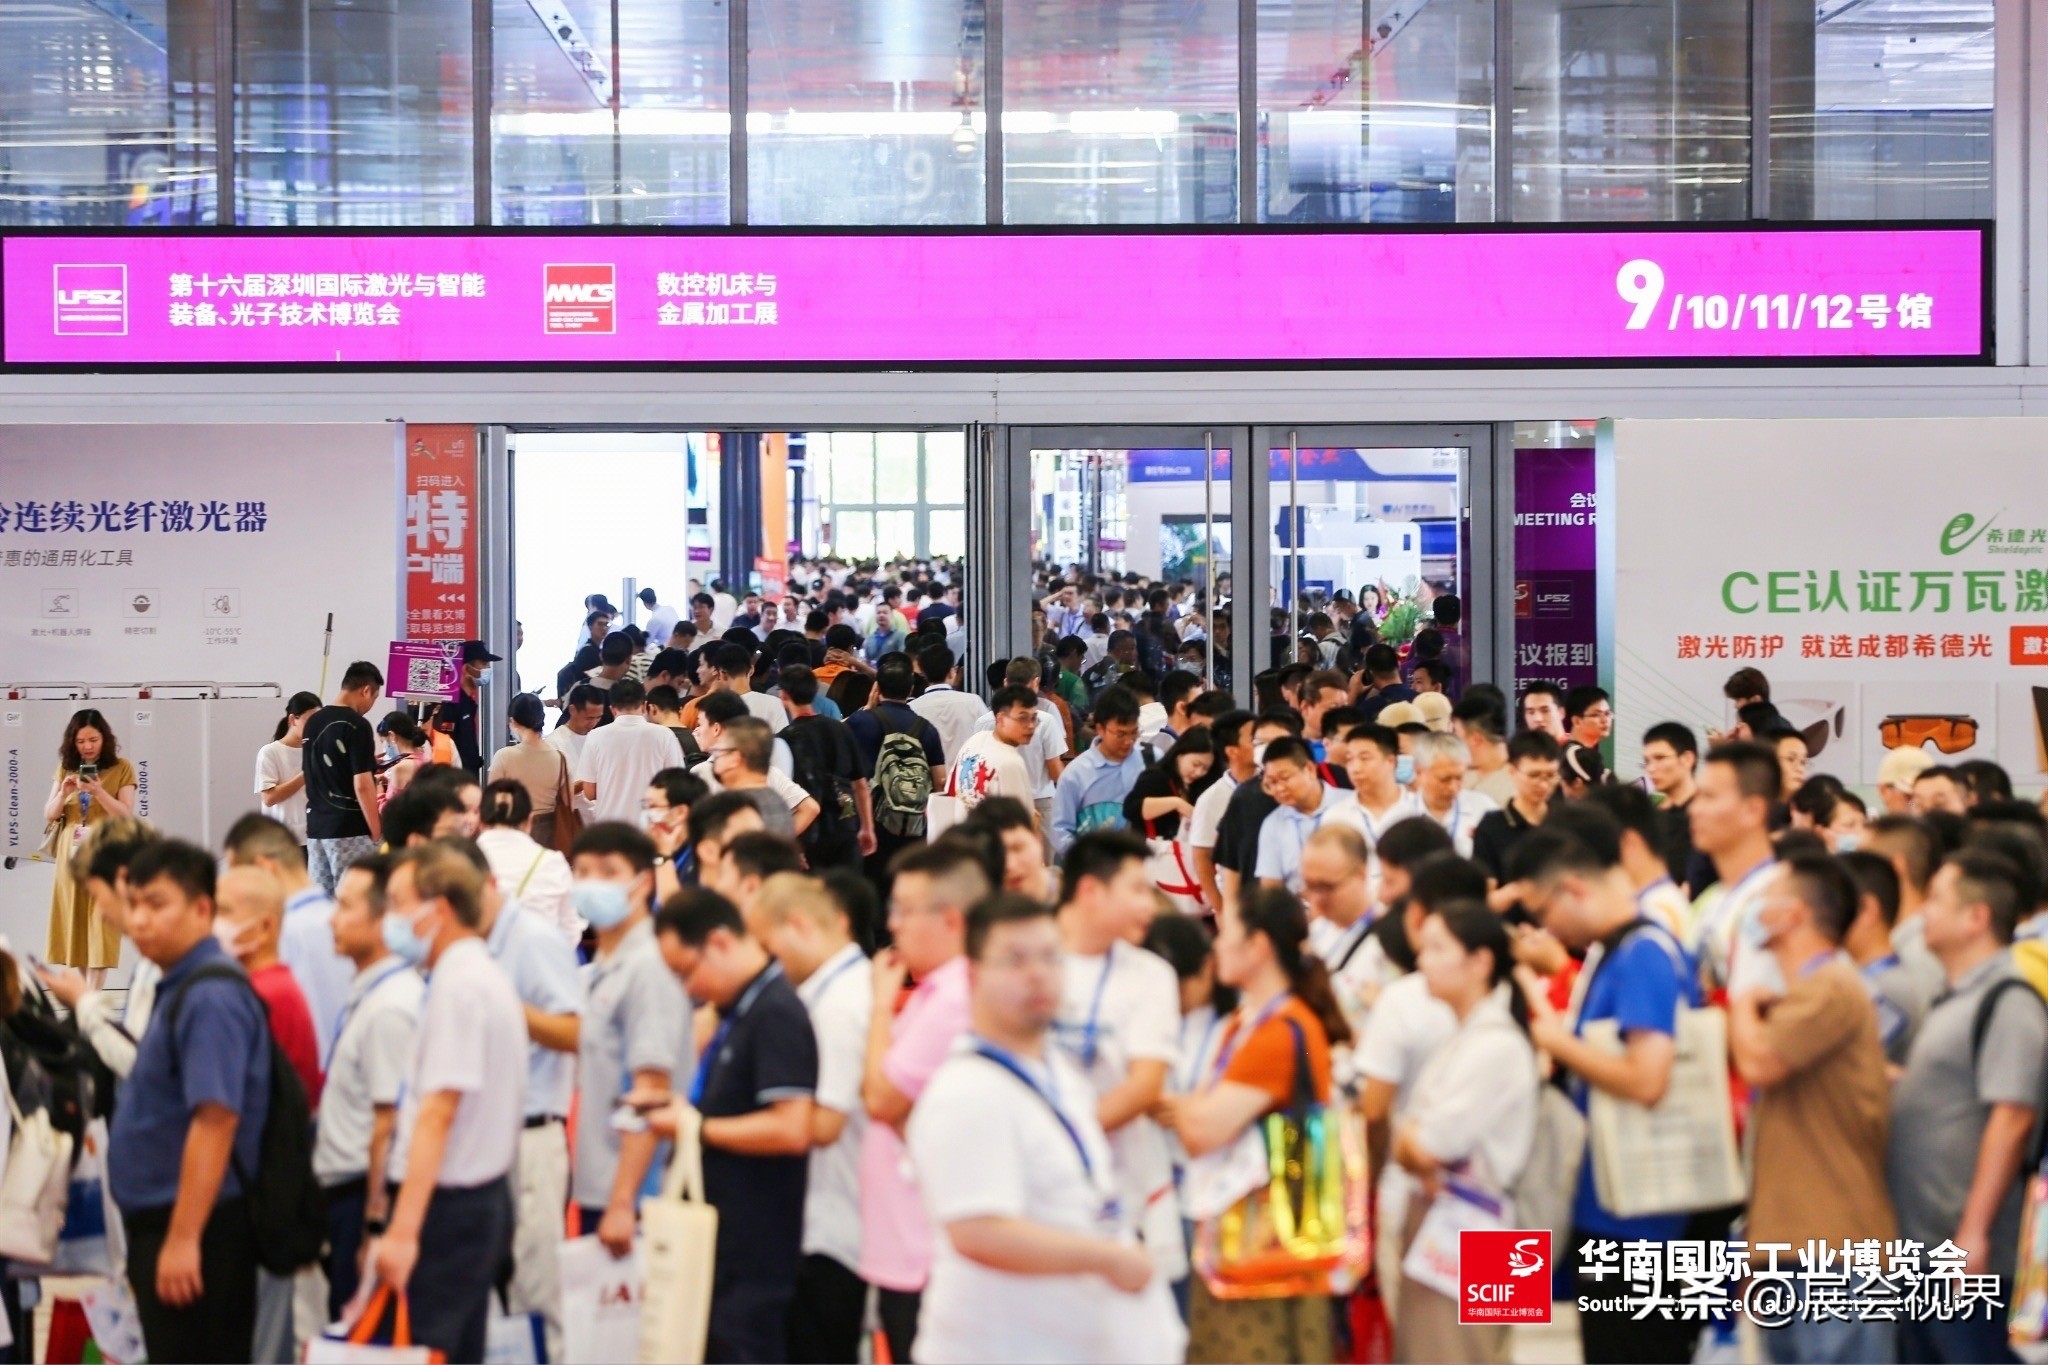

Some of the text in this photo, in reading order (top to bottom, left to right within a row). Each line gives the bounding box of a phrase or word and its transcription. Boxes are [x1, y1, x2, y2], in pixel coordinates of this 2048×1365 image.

[169, 273, 486, 298] 第十六届深圳国际激光与智能
[656, 271, 778, 297] 数控机床与
[58, 289, 123, 305] LPSZ
[169, 302, 402, 327] 装备、光子技术博览会
[656, 301, 779, 326] 金属加工展
[416, 475, 465, 487] 扫码进入
[1514, 512, 1585, 526] MEETING
[0, 548, 134, 567] 惠的通用化工具
[1536, 594, 1571, 602] LPSZ
[407, 608, 465, 620] 全景看文博
[1515, 643, 1594, 666] 议报到
[1677, 634, 1994, 659] 激光防护 就选成都希德光
[8, 748, 19, 847] YLPS-Clean-2000-A
